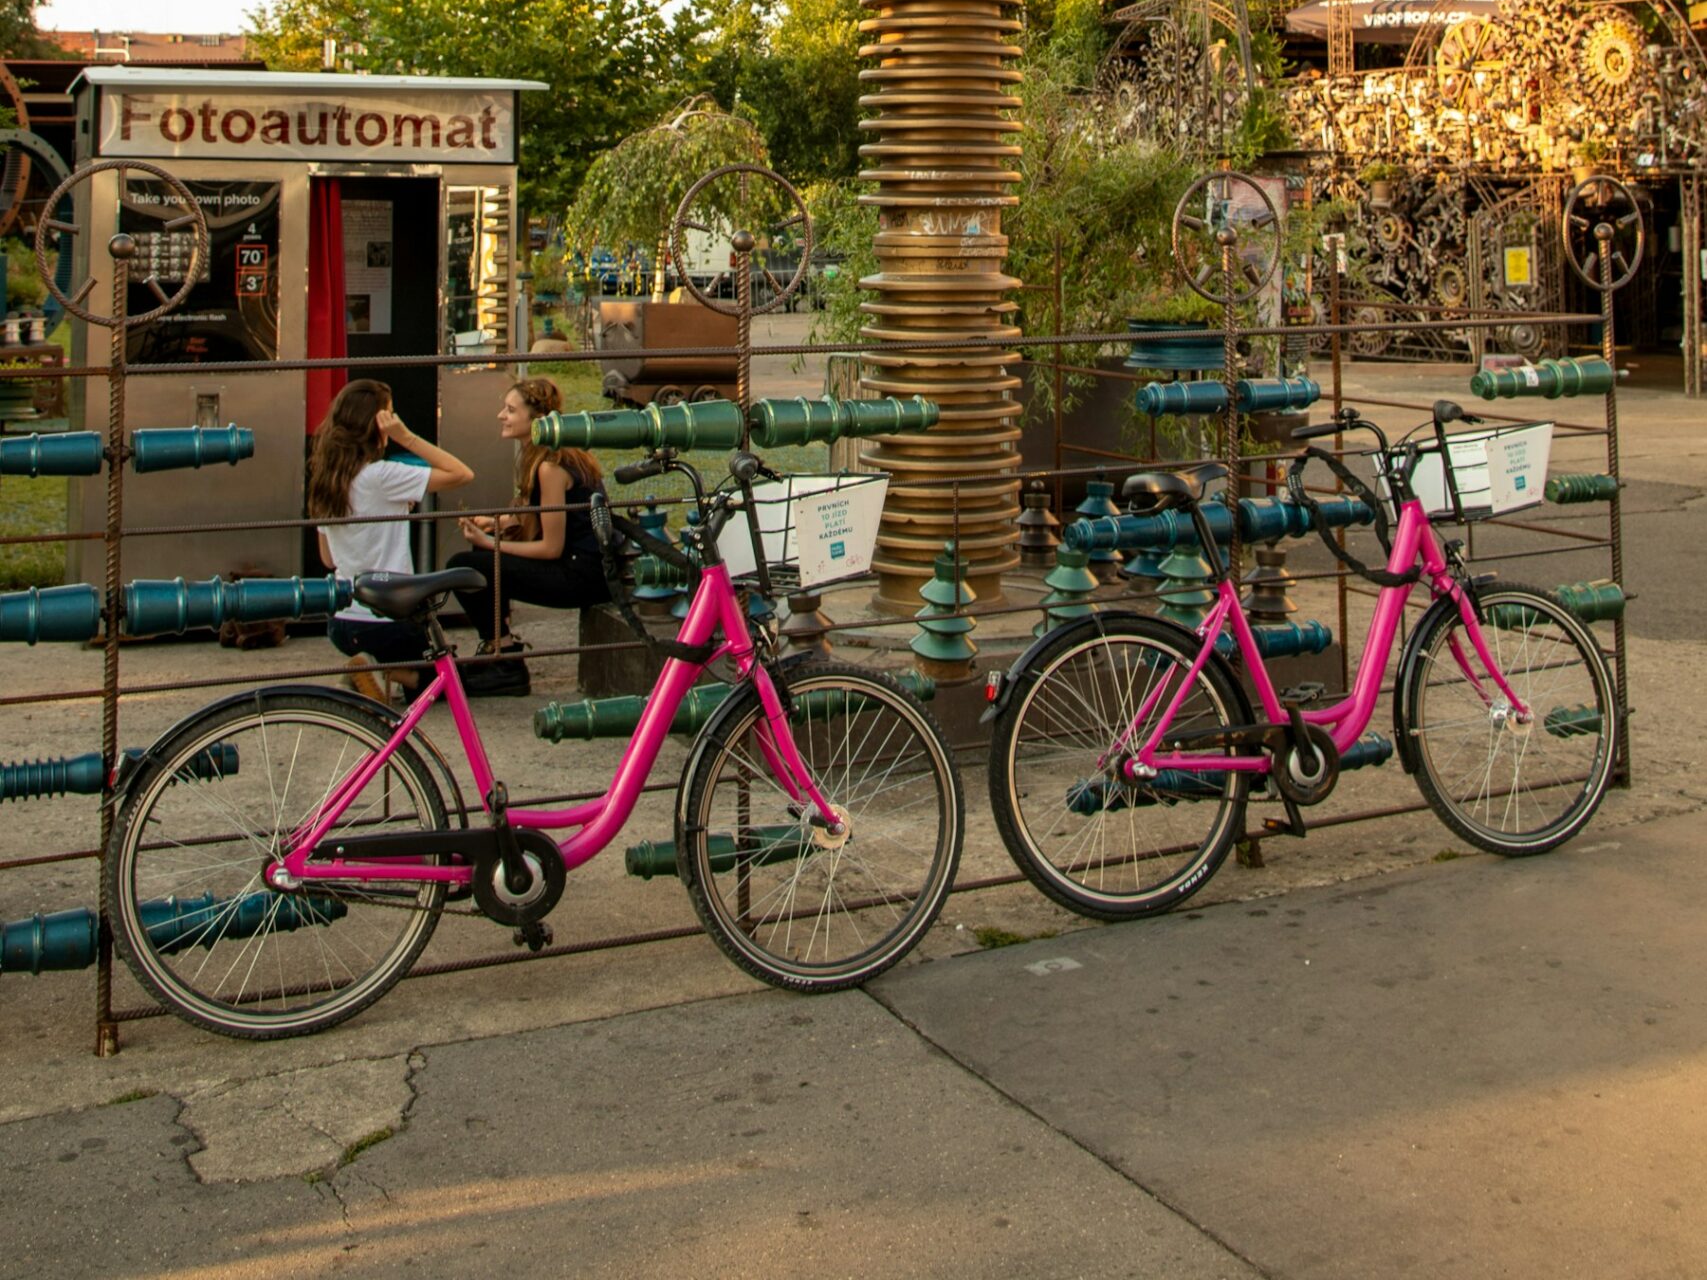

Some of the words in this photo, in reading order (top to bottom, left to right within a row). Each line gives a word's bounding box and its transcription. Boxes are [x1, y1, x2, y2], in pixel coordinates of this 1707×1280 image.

[120, 94, 497, 150] Fotoautomat
[131, 193, 160, 205] Take
[163, 194, 191, 206] you
[224, 194, 261, 206] photo
[248, 223, 256, 234] 4
[241, 249, 261, 264] 70
[246, 276, 257, 291] 3
[818, 500, 849, 512] PRVNÍCH
[819, 527, 853, 539] KAŽDÉMU
[1178, 863, 1209, 893] KENDA
